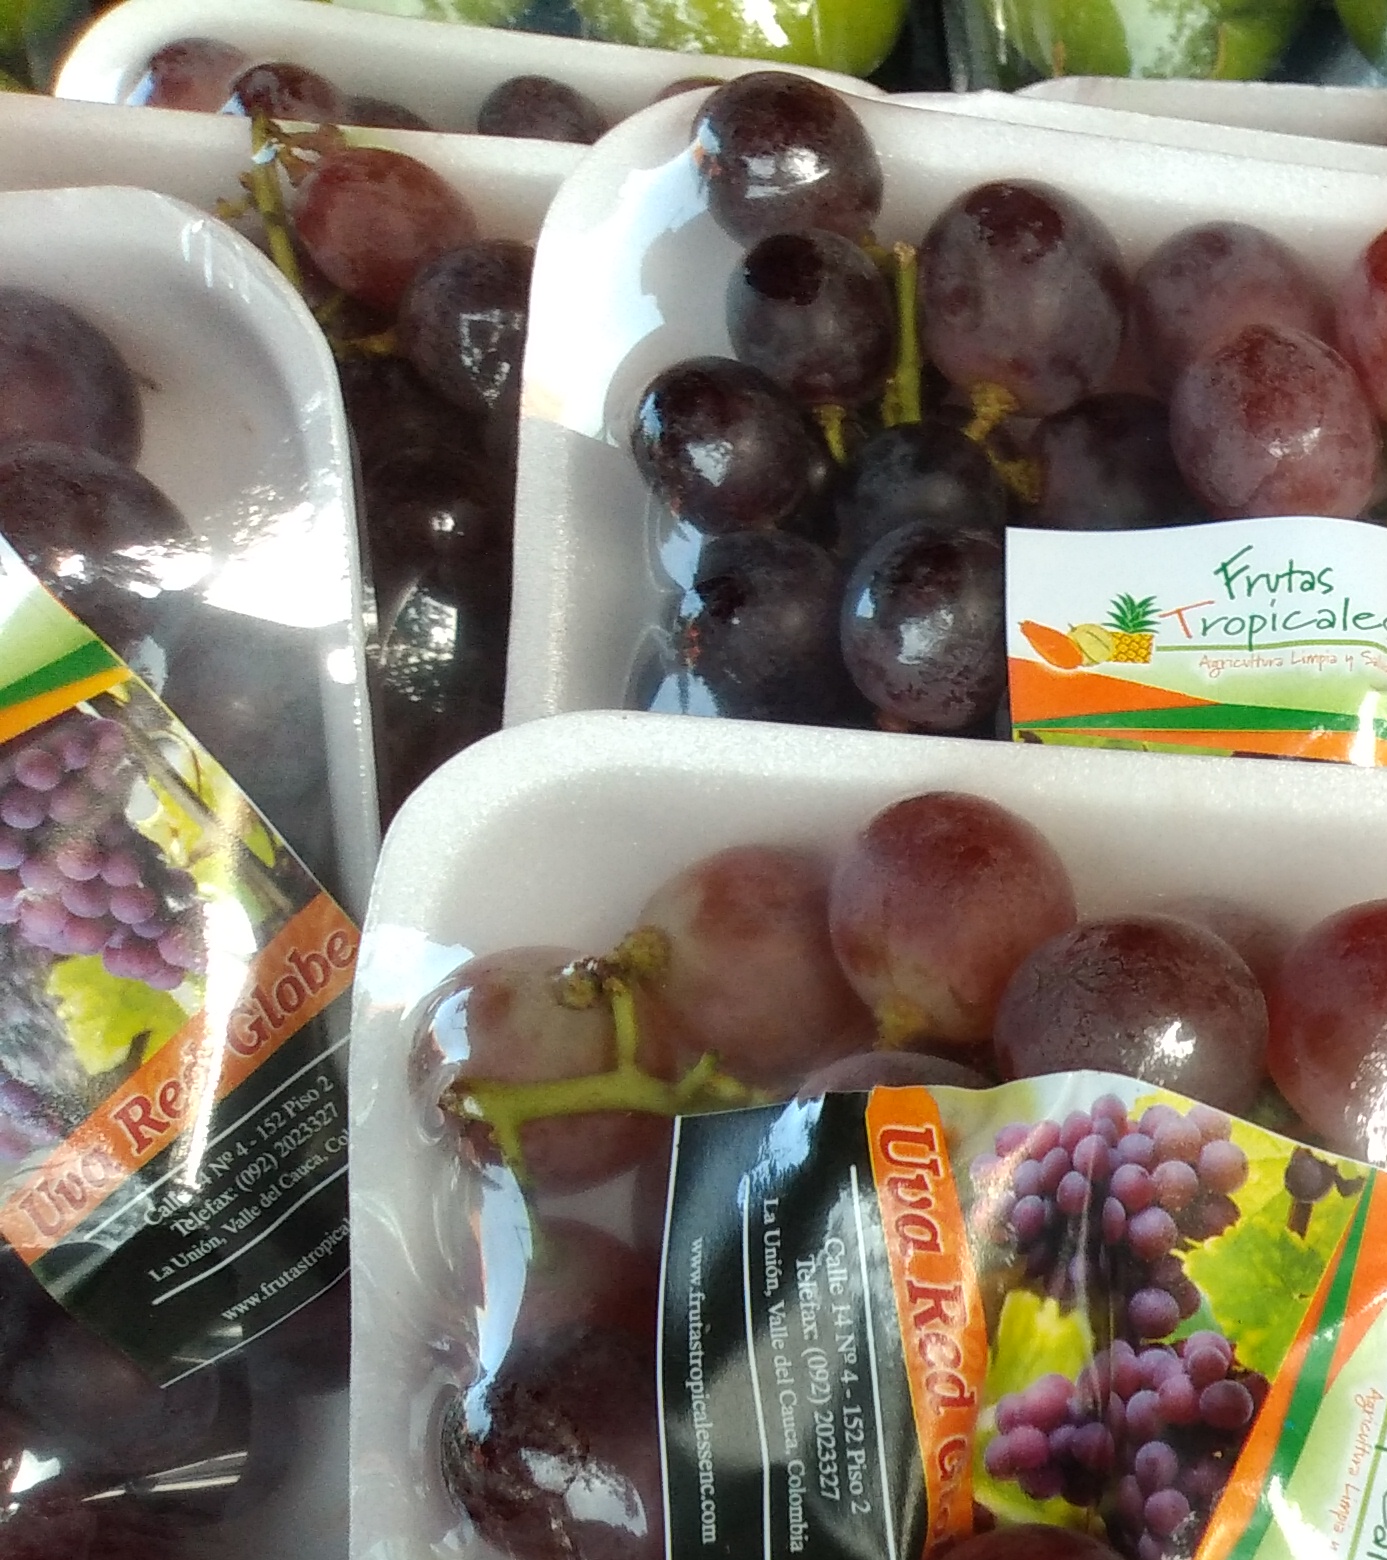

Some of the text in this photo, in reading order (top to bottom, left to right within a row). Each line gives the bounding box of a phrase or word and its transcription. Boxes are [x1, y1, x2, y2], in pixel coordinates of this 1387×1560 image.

[1213, 545, 1334, 600] Frutas
[1199, 651, 1284, 678] Agricultura
[1290, 650, 1338, 669] Limpia
[1345, 654, 1354, 672] y
[18, 1150, 122, 1238] Uva
[228, 929, 357, 1058] Globe
[144, 1190, 190, 1226] Call
[235, 1140, 248, 1157] 4
[255, 1112, 287, 1142] 152
[282, 1089, 320, 1119] Piso
[316, 1075, 334, 1092] 2
[170, 1101, 339, 1238] Telefax: (092) 2023327
[879, 1124, 942, 1254] Uva
[147, 1153, 329, 1283] La Unión, Valle del Cauca,
[824, 1237, 848, 1296] Calle
[763, 1198, 808, 1553] La Unión, Valle del Cauca, Colombia
[796, 1254, 840, 1501] Telefax: (092) 2023327
[832, 1304, 853, 1327] 14
[840, 1368, 858, 1384] 4
[905, 1278, 976, 1414] Red
[685, 1237, 717, 1544] www.frutastropicalessenc.com
[843, 1404, 864, 1442] 152
[846, 1448, 867, 1497] Piso
[851, 1501, 871, 1514] 2
[1329, 1387, 1385, 1534] Agricultura Limpia
